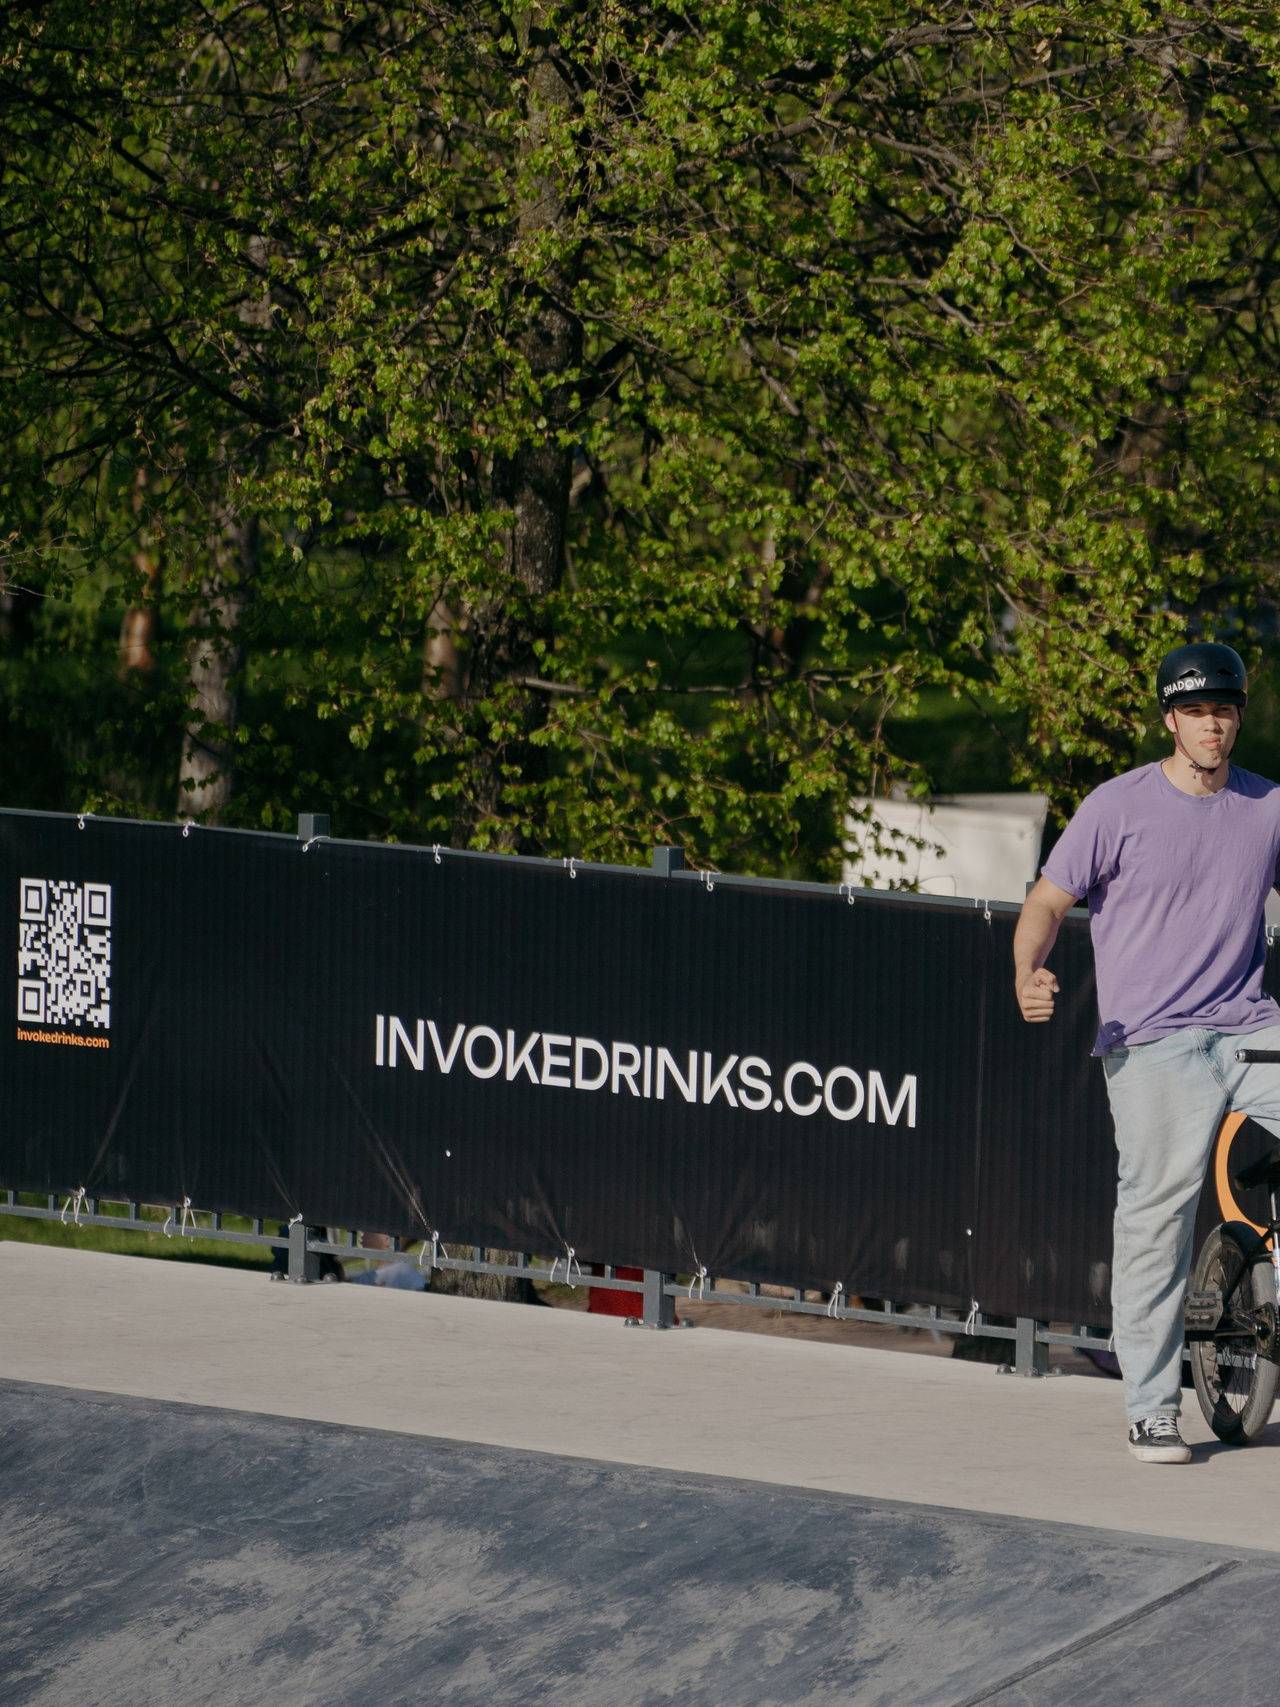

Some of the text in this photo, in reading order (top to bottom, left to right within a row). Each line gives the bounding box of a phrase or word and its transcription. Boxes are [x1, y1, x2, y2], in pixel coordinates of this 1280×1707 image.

[1163, 677, 1206, 697] SHADOW
[17, 1026, 110, 1048] invokedrinks.com
[376, 1013, 917, 1128] INVOKEDRINKS.COM
